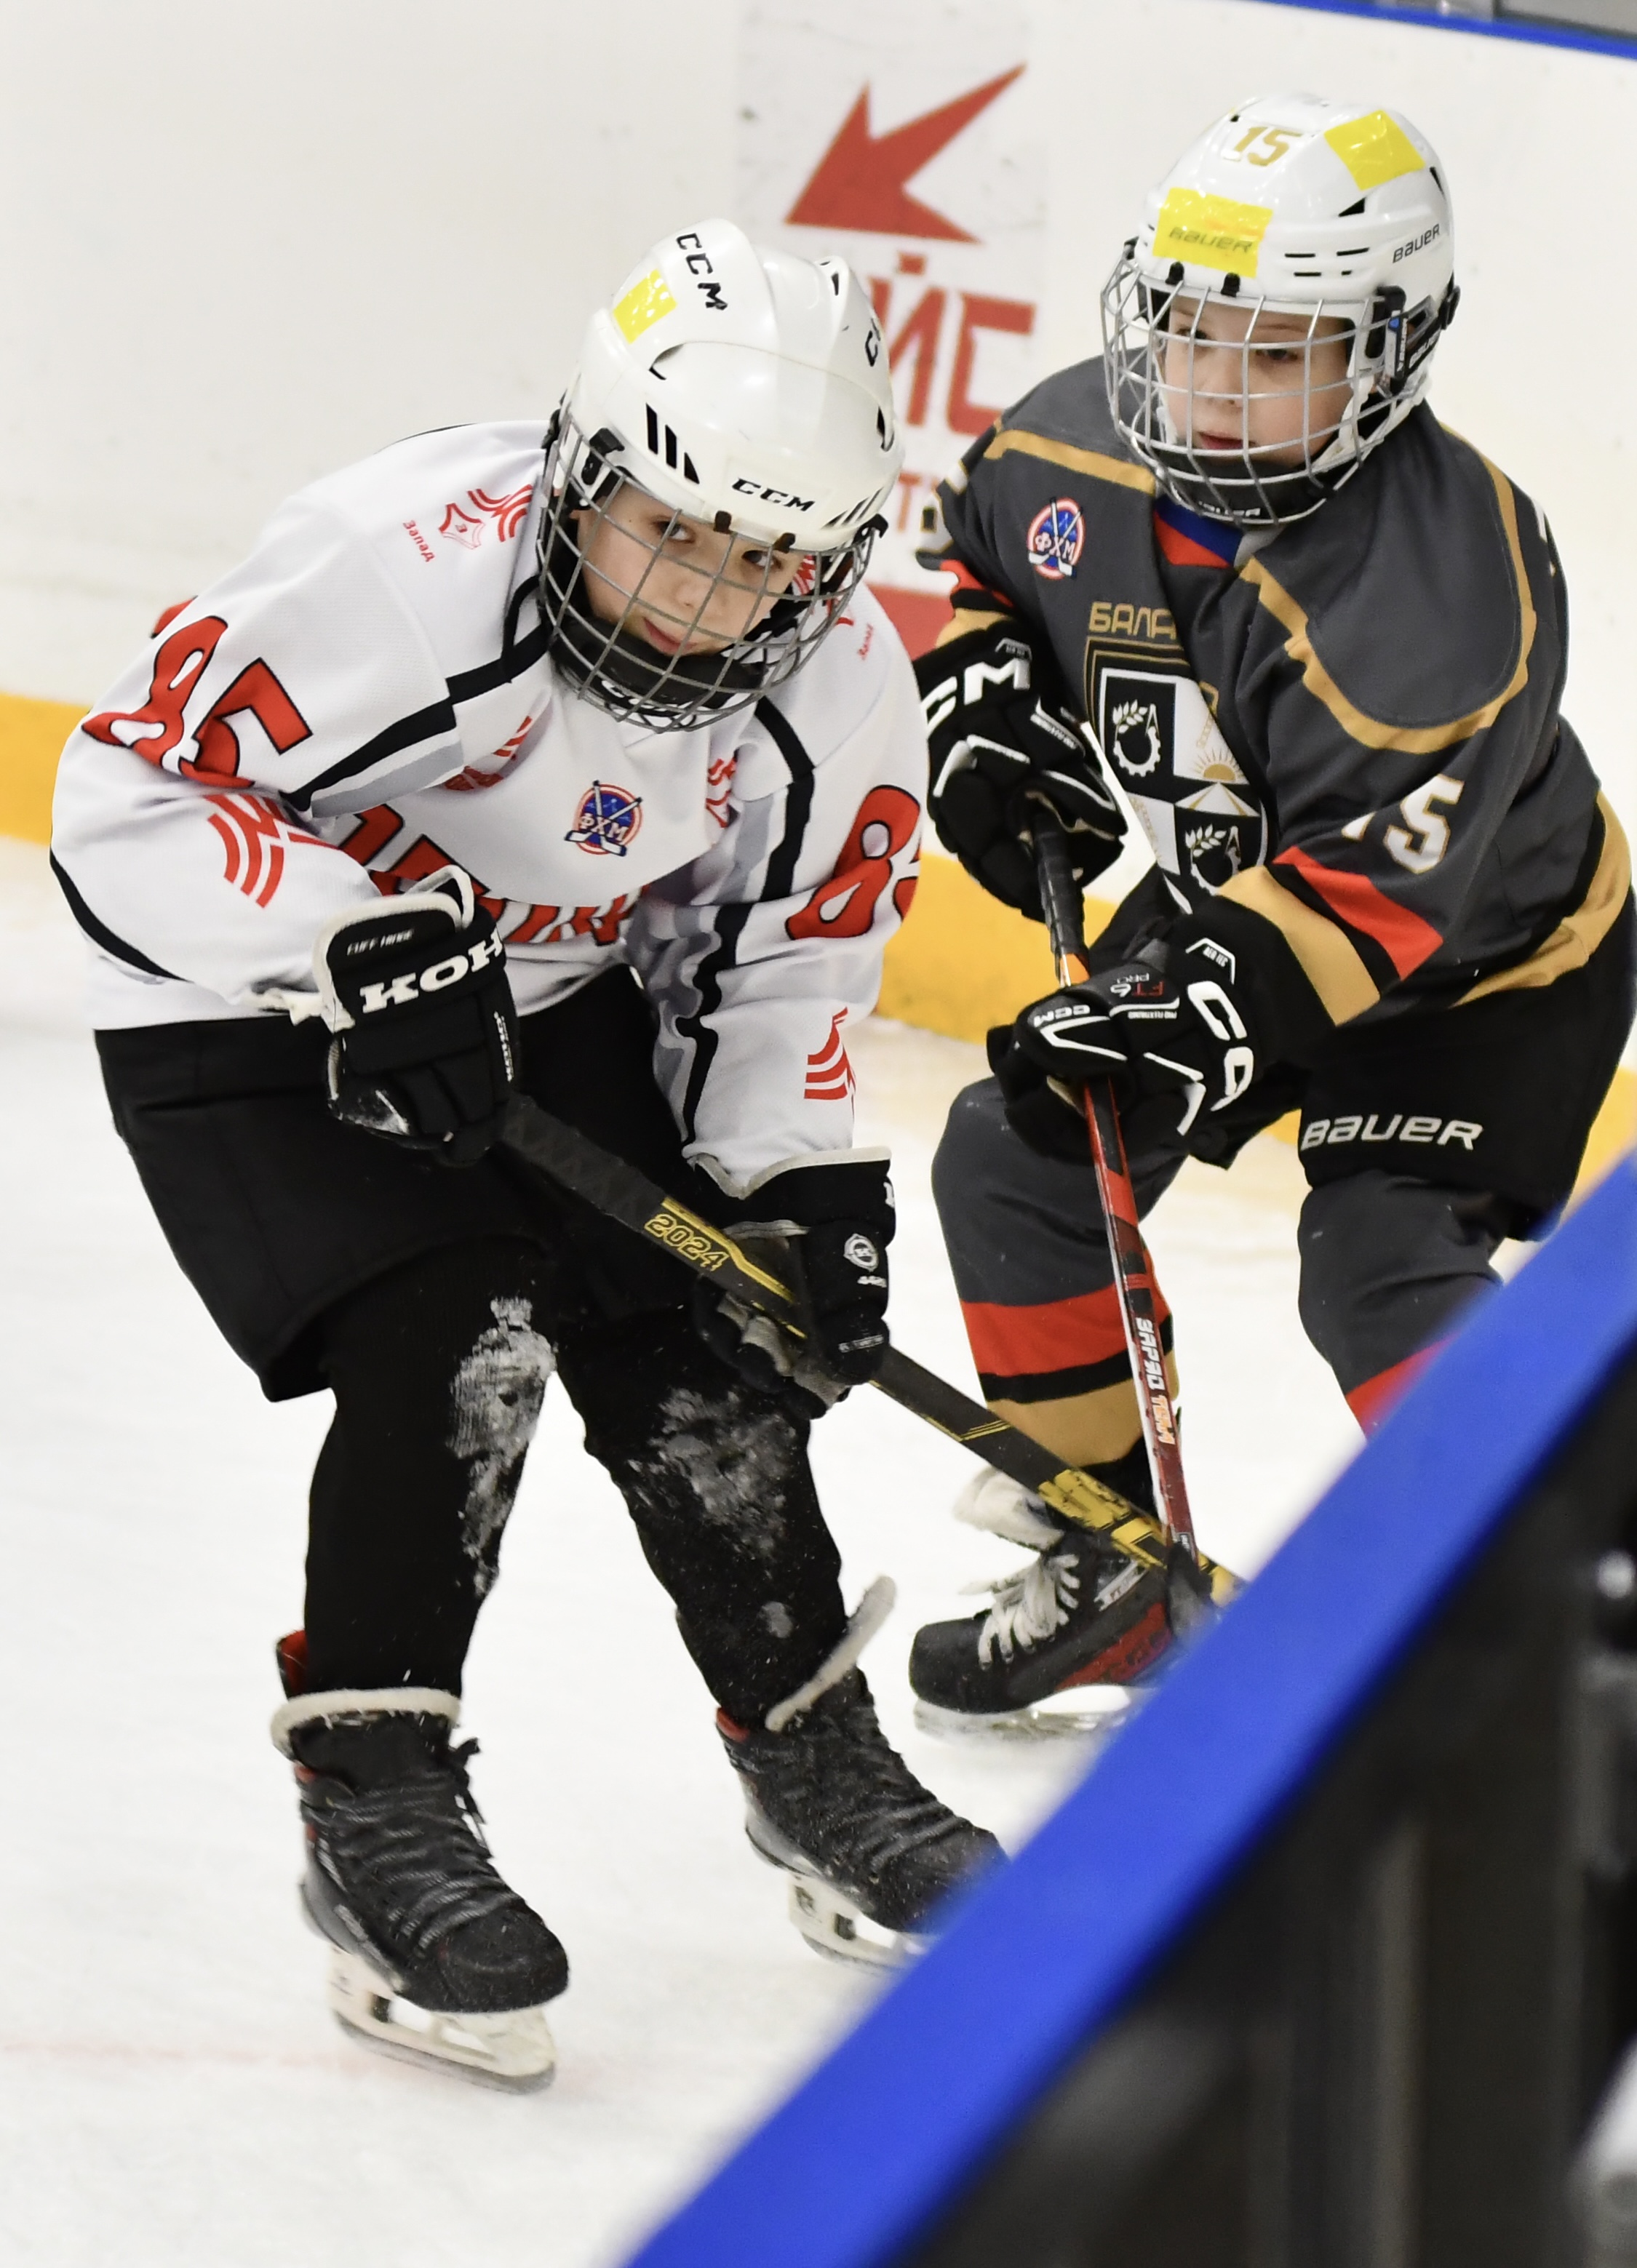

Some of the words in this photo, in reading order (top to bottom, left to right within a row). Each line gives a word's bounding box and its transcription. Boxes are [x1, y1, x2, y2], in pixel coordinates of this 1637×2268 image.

[1233, 126, 1304, 167] 15
[1168, 225, 1252, 254] BAUER
[1392, 223, 1441, 263] BAUER
[676, 233, 728, 311] CCM
[869, 252, 1036, 436] ЙС
[731, 477, 816, 512] CCM
[402, 519, 436, 563] Запад
[1035, 532, 1076, 562] ФХМ
[1088, 601, 1177, 639] БАЛА
[920, 657, 1030, 738] CM
[578, 812, 629, 841] ФХМ
[786, 785, 920, 941] 8
[359, 925, 504, 1014] KOH
[1033, 1004, 1090, 1027] CCM
[1300, 1113, 1484, 1151] BAUER
[644, 1213, 730, 1271] 2024
